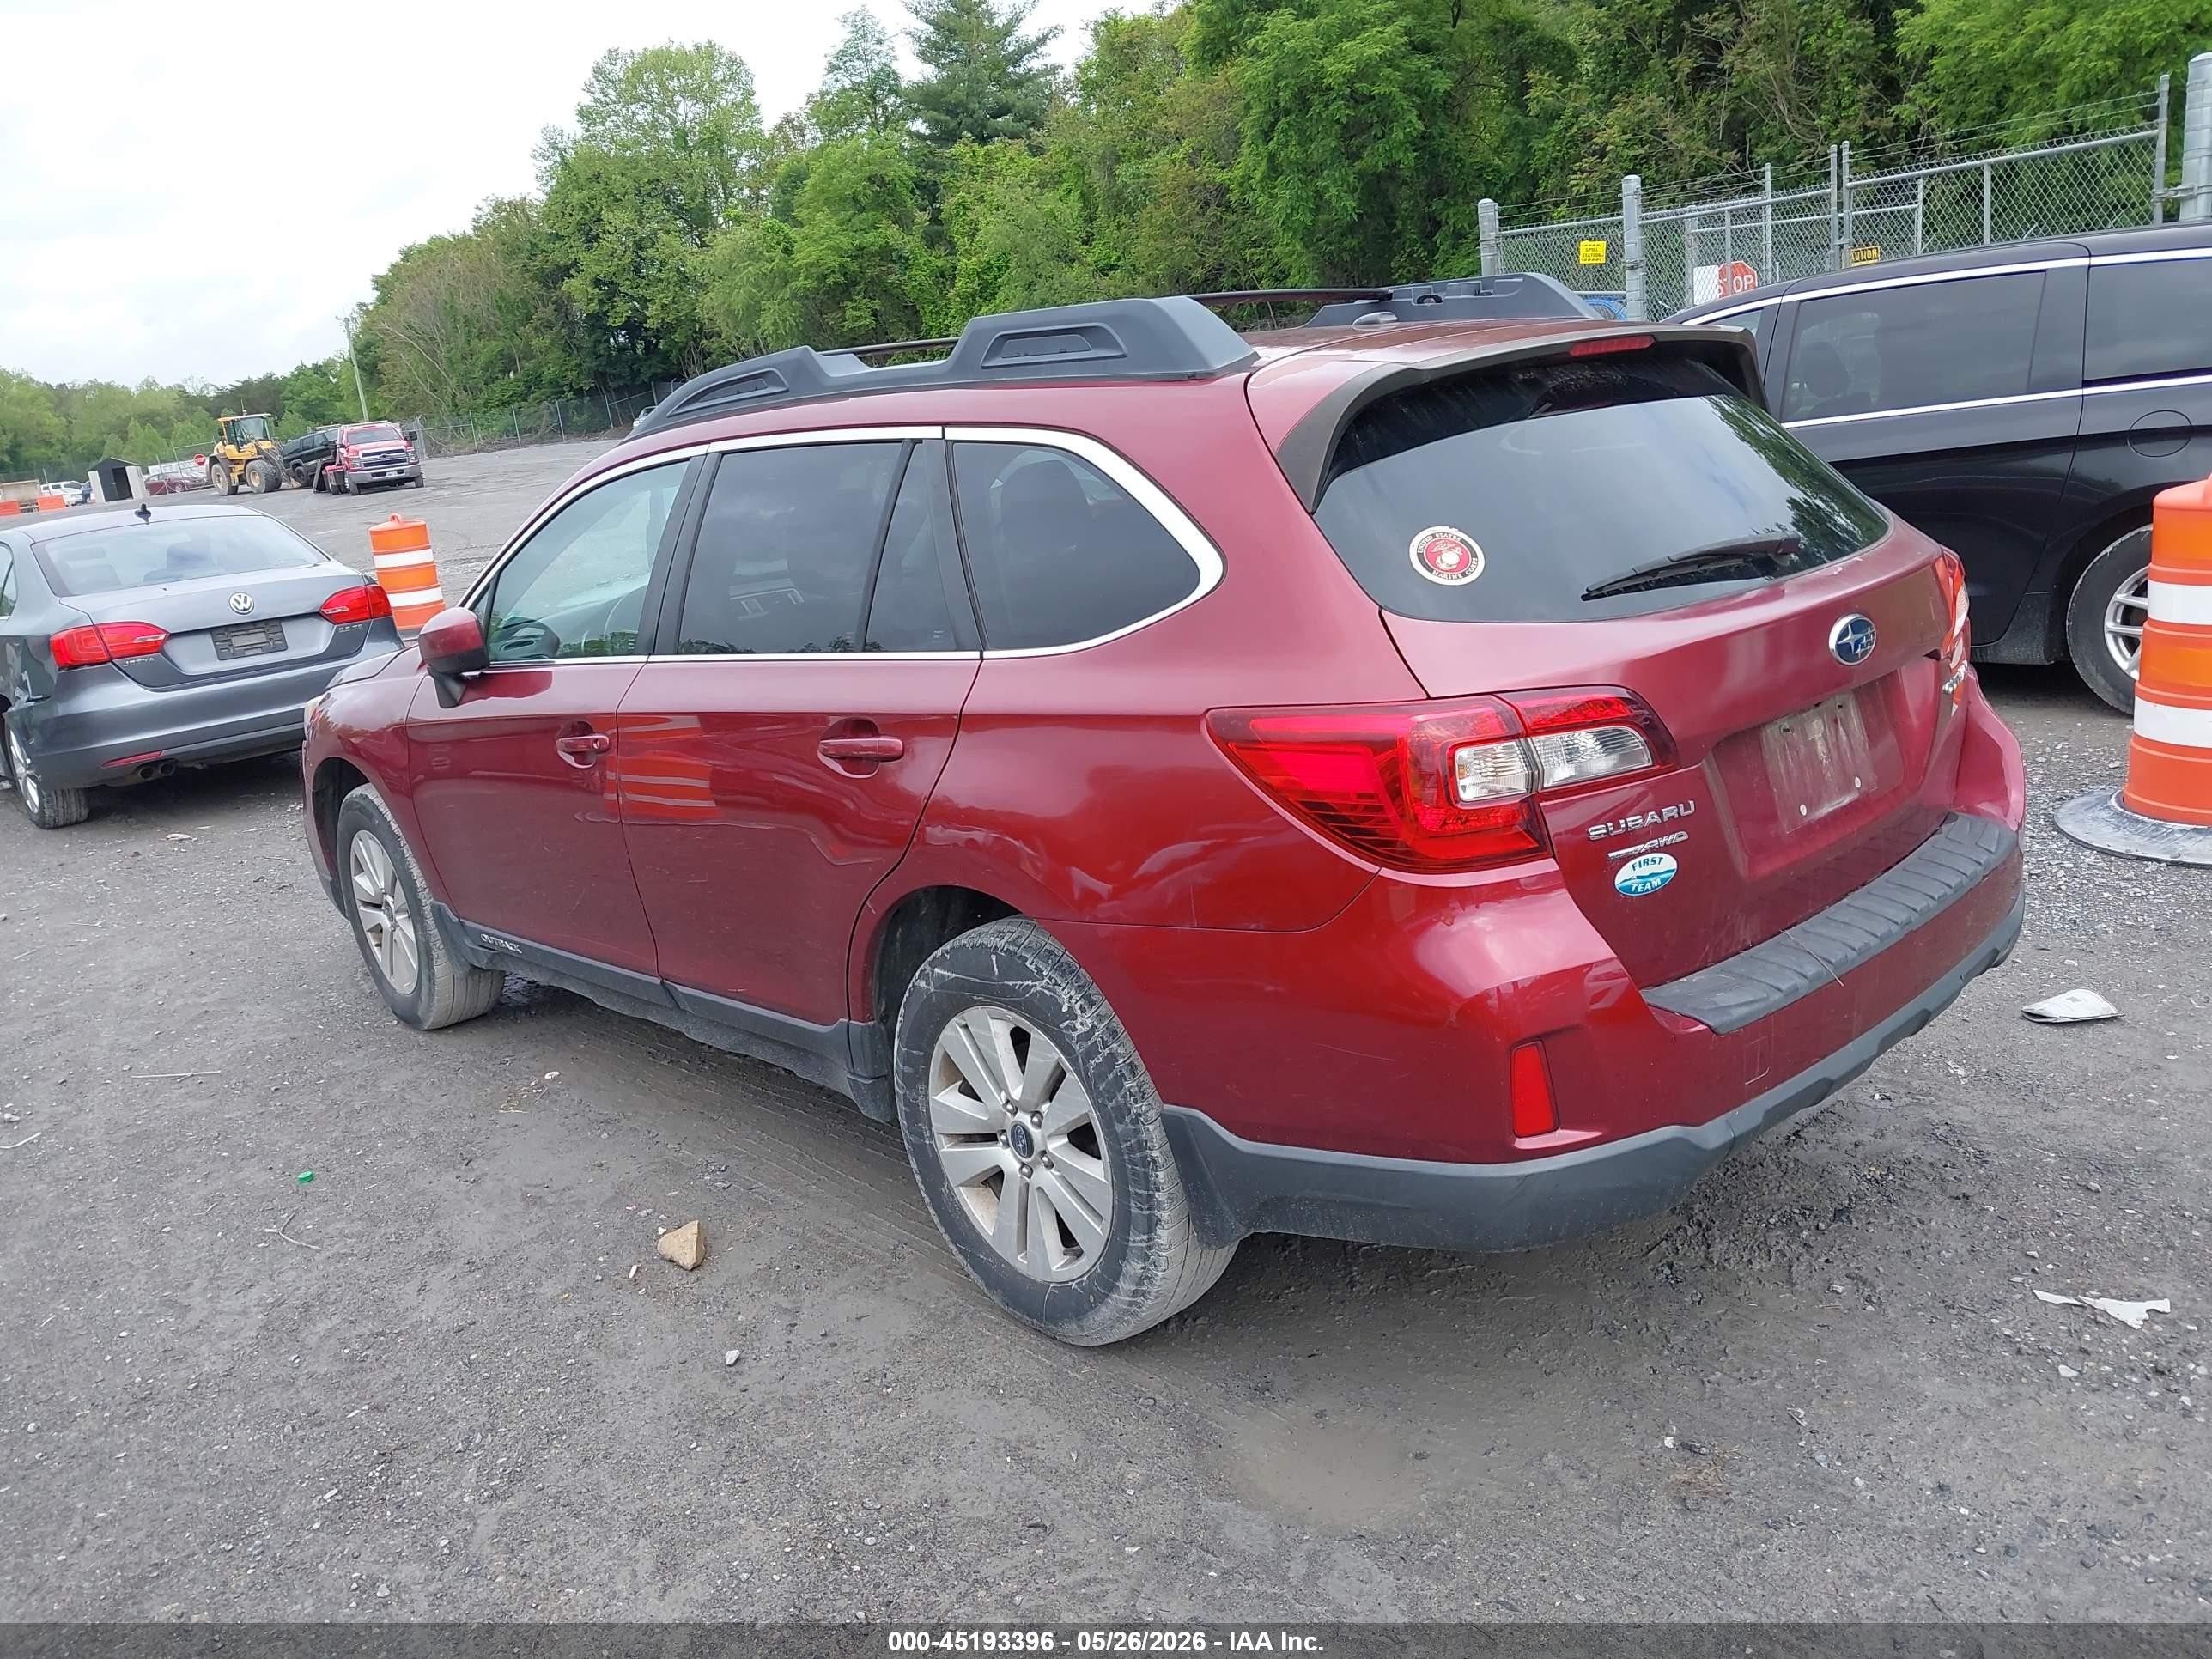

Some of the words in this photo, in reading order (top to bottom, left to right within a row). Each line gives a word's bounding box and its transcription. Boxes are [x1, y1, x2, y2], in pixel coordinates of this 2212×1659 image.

[1850, 248, 1878, 263] AUTION
[1435, 532, 1462, 543] STATES
[1431, 570, 1464, 580] MARINE
[1587, 799, 1697, 841] SUBARU
[1631, 856, 1664, 872] FIRST
[1630, 878, 1662, 893] TEAM
[480, 933, 523, 954] OUTBACK
